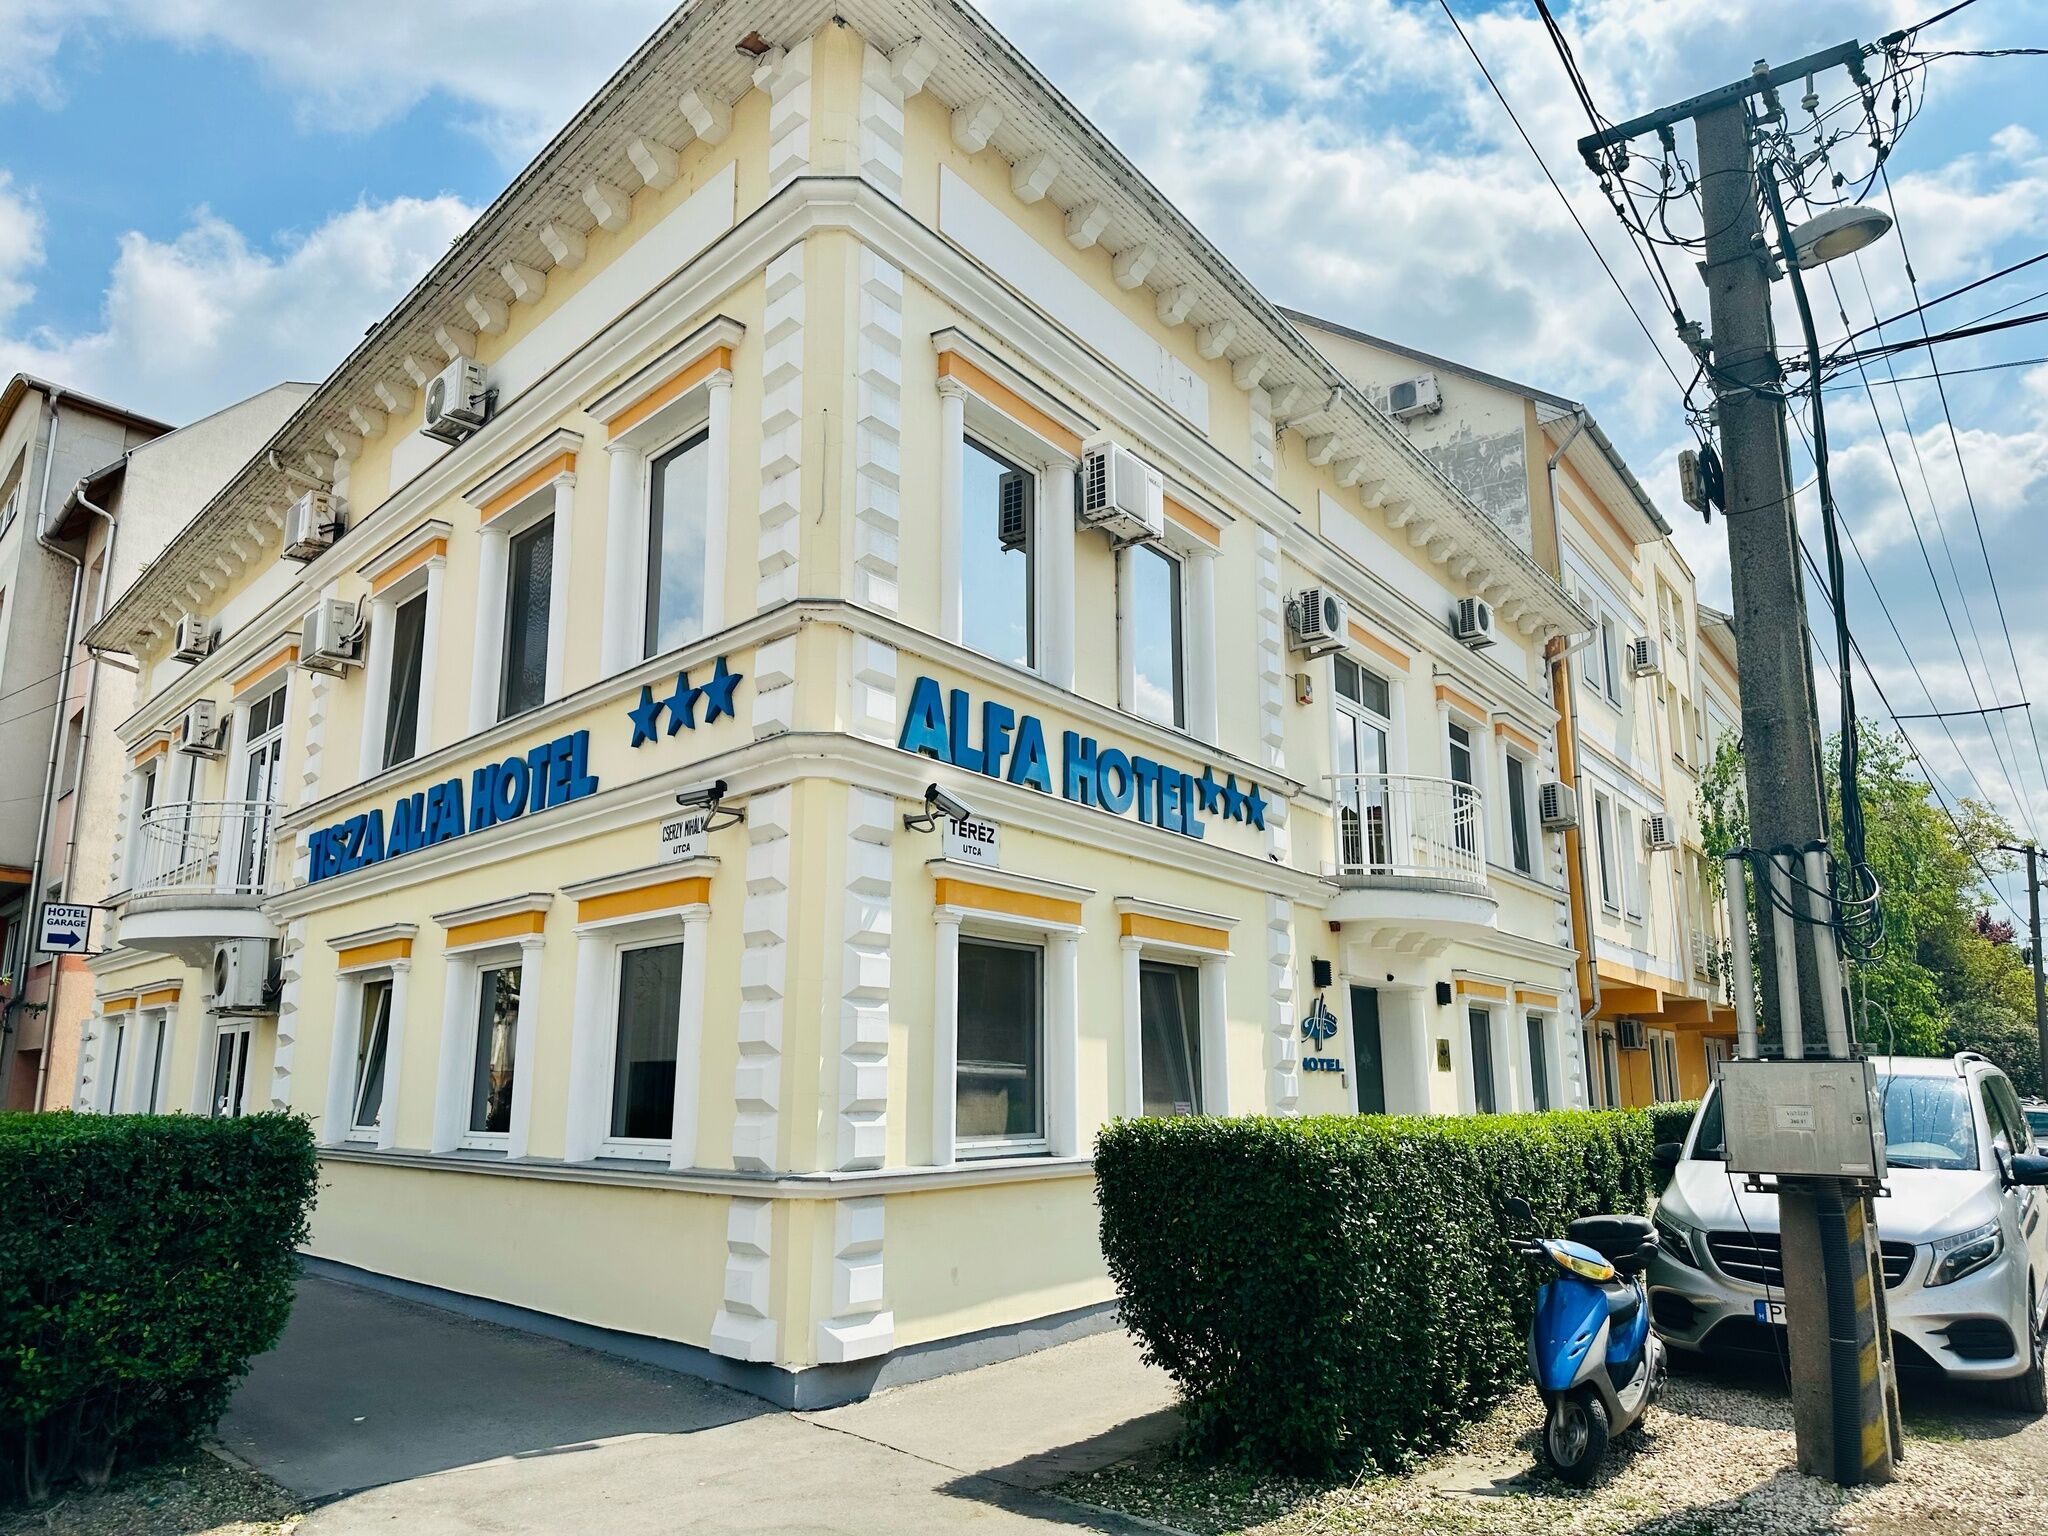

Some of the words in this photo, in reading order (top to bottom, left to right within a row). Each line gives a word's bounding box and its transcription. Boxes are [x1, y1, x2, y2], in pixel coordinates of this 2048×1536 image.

[898, 676, 1053, 794] ALFA
[1063, 730, 1206, 839] HOTEL
[308, 808, 385, 883] TISZA
[386, 777, 466, 860] ALFA
[469, 730, 599, 833] HOTEL
[662, 821, 684, 842] CSERZY
[949, 818, 995, 844] TERÉZ
[673, 843, 691, 855] UTCA
[962, 844, 982, 856] UTCA
[48, 907, 87, 918] HOTEL
[47, 918, 86, 927] GARAGE
[1770, 1305, 1787, 1323] P
